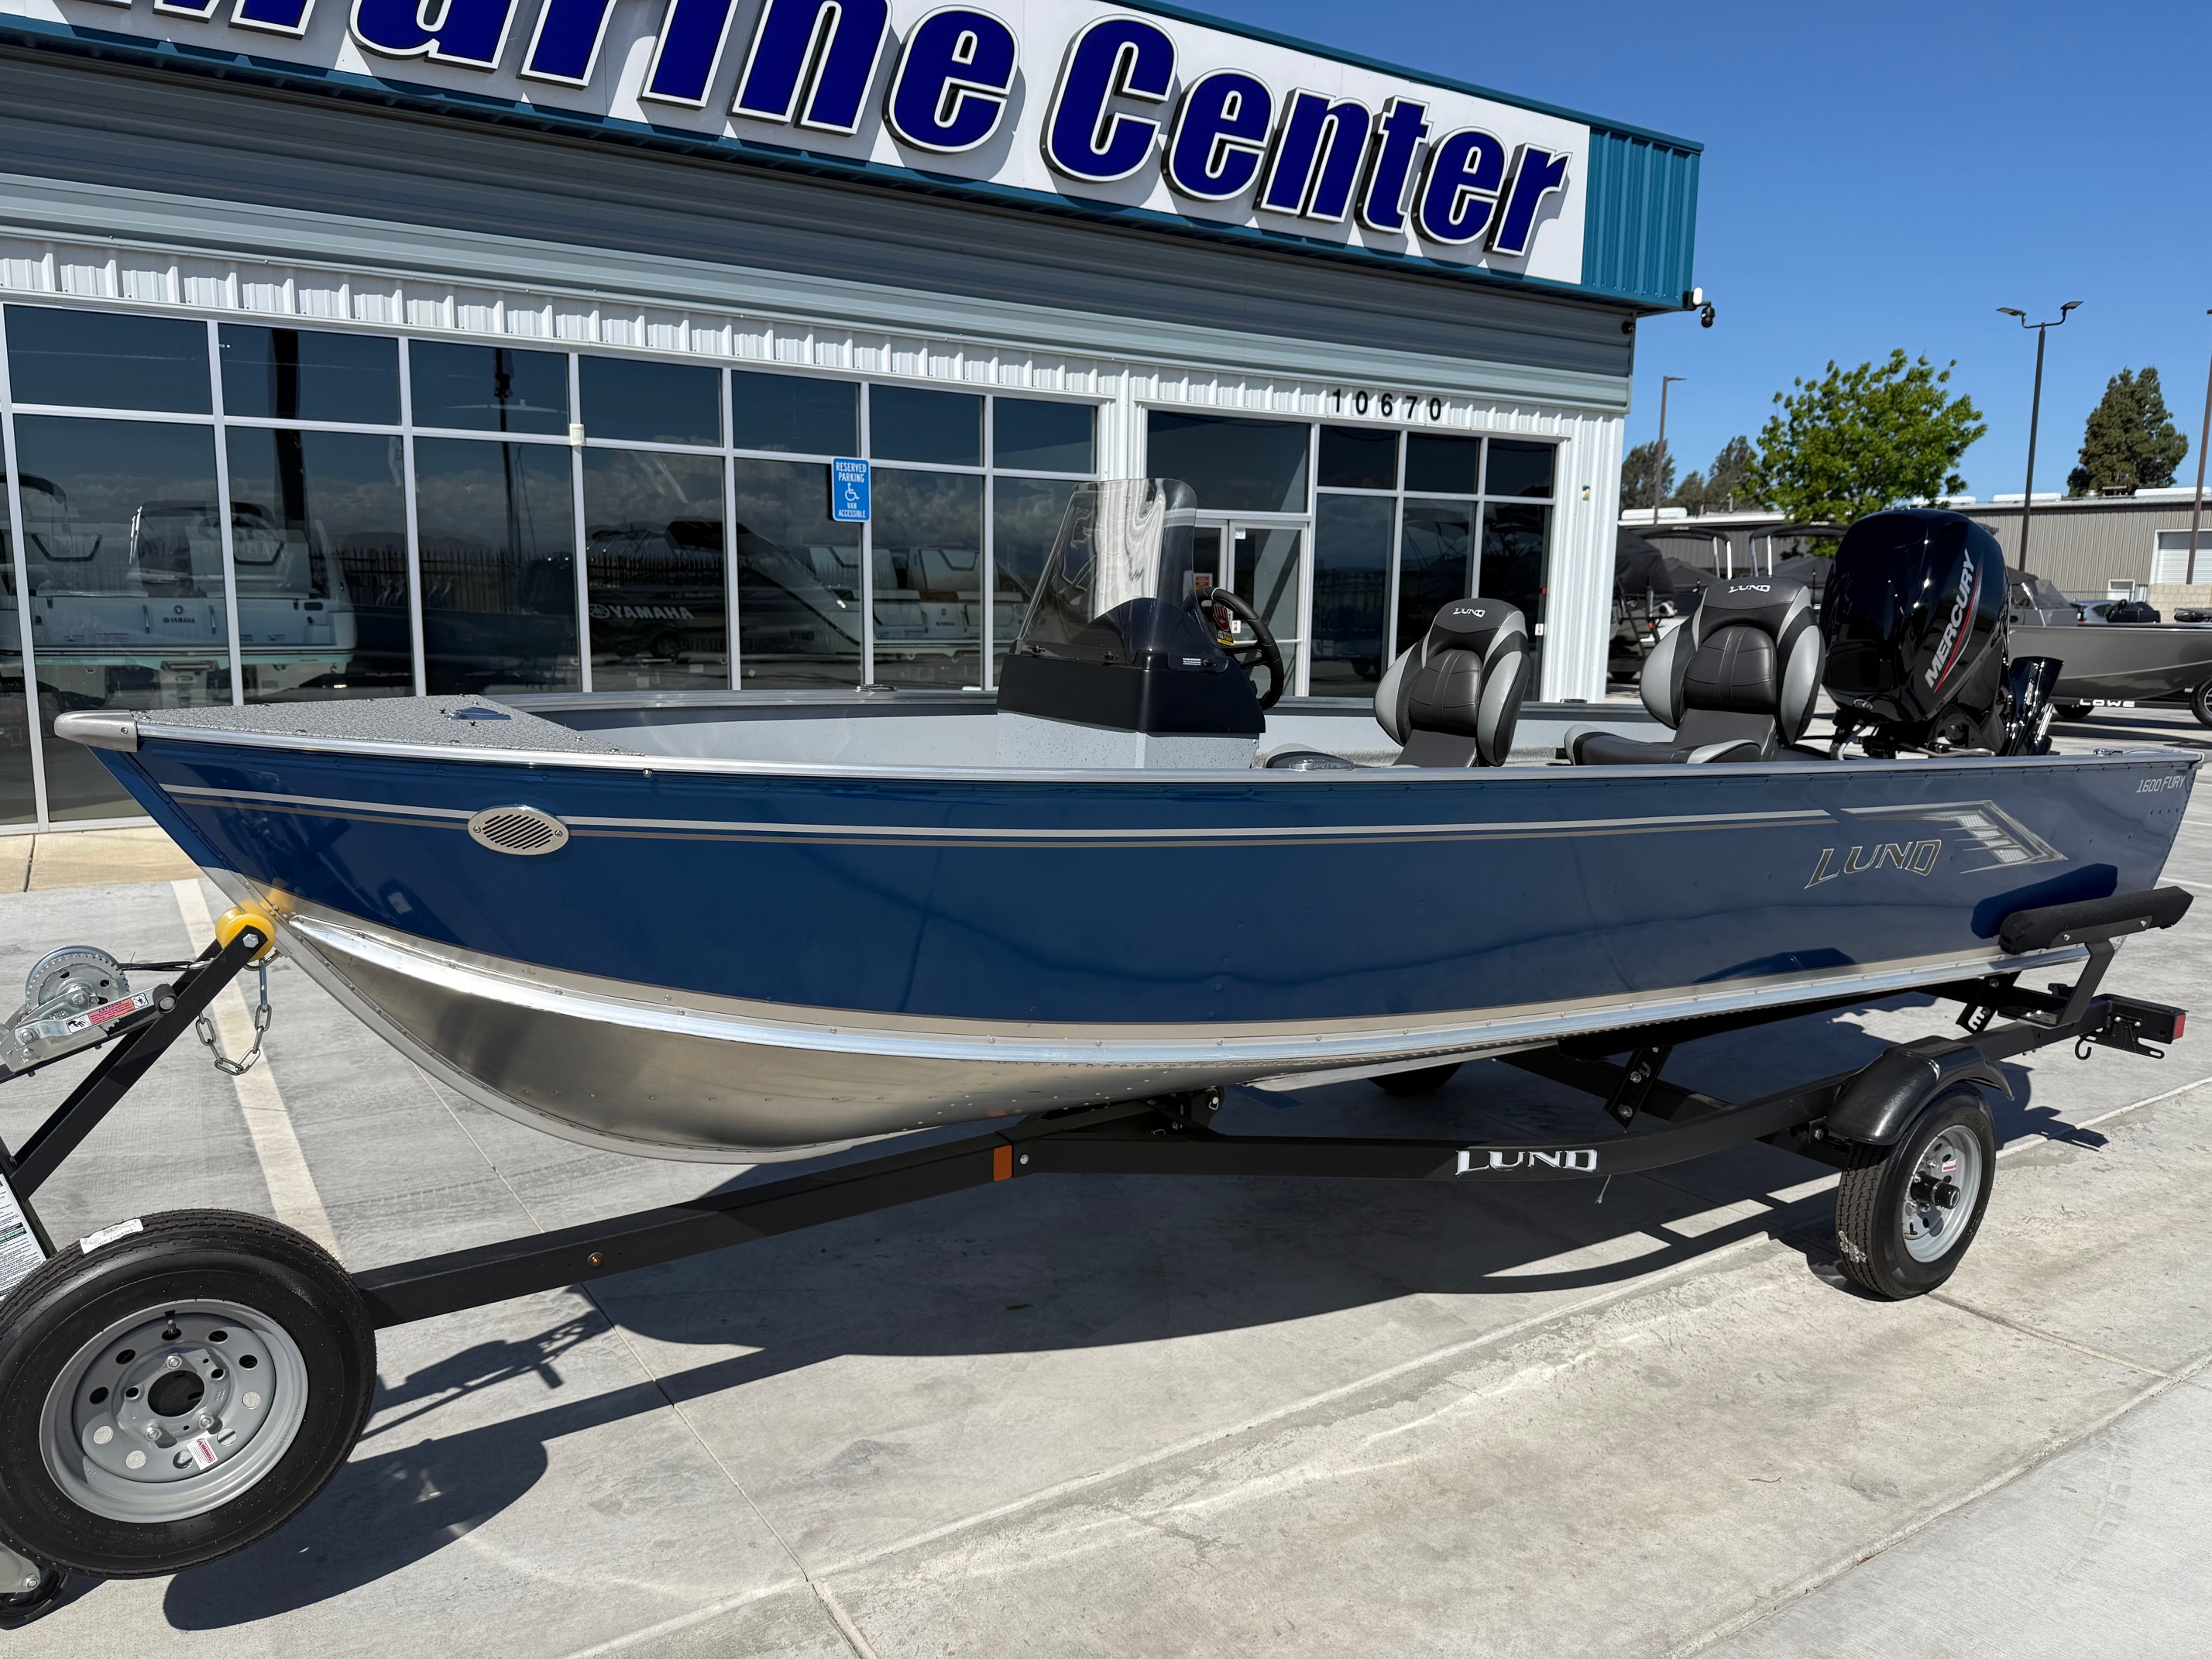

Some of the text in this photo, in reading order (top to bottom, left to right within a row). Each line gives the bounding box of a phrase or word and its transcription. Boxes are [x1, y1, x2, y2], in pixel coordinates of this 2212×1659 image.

[84, 0, 1573, 257] rine Center
[1332, 388, 1442, 421] 10670
[836, 462, 867, 473] RESERVED
[838, 472, 865, 483] PARKING
[839, 510, 866, 518] ACCESSIBLE
[1728, 585, 1771, 593] LUND
[610, 606, 695, 620] YAMAHA
[1453, 608, 1486, 618] LUND
[1925, 548, 1974, 689] MERCURY
[2080, 699, 2135, 708] LOWE
[2136, 775, 2186, 793] 1600 FURY
[1804, 840, 1942, 889] LUND
[1455, 1150, 1598, 1176] LUND
